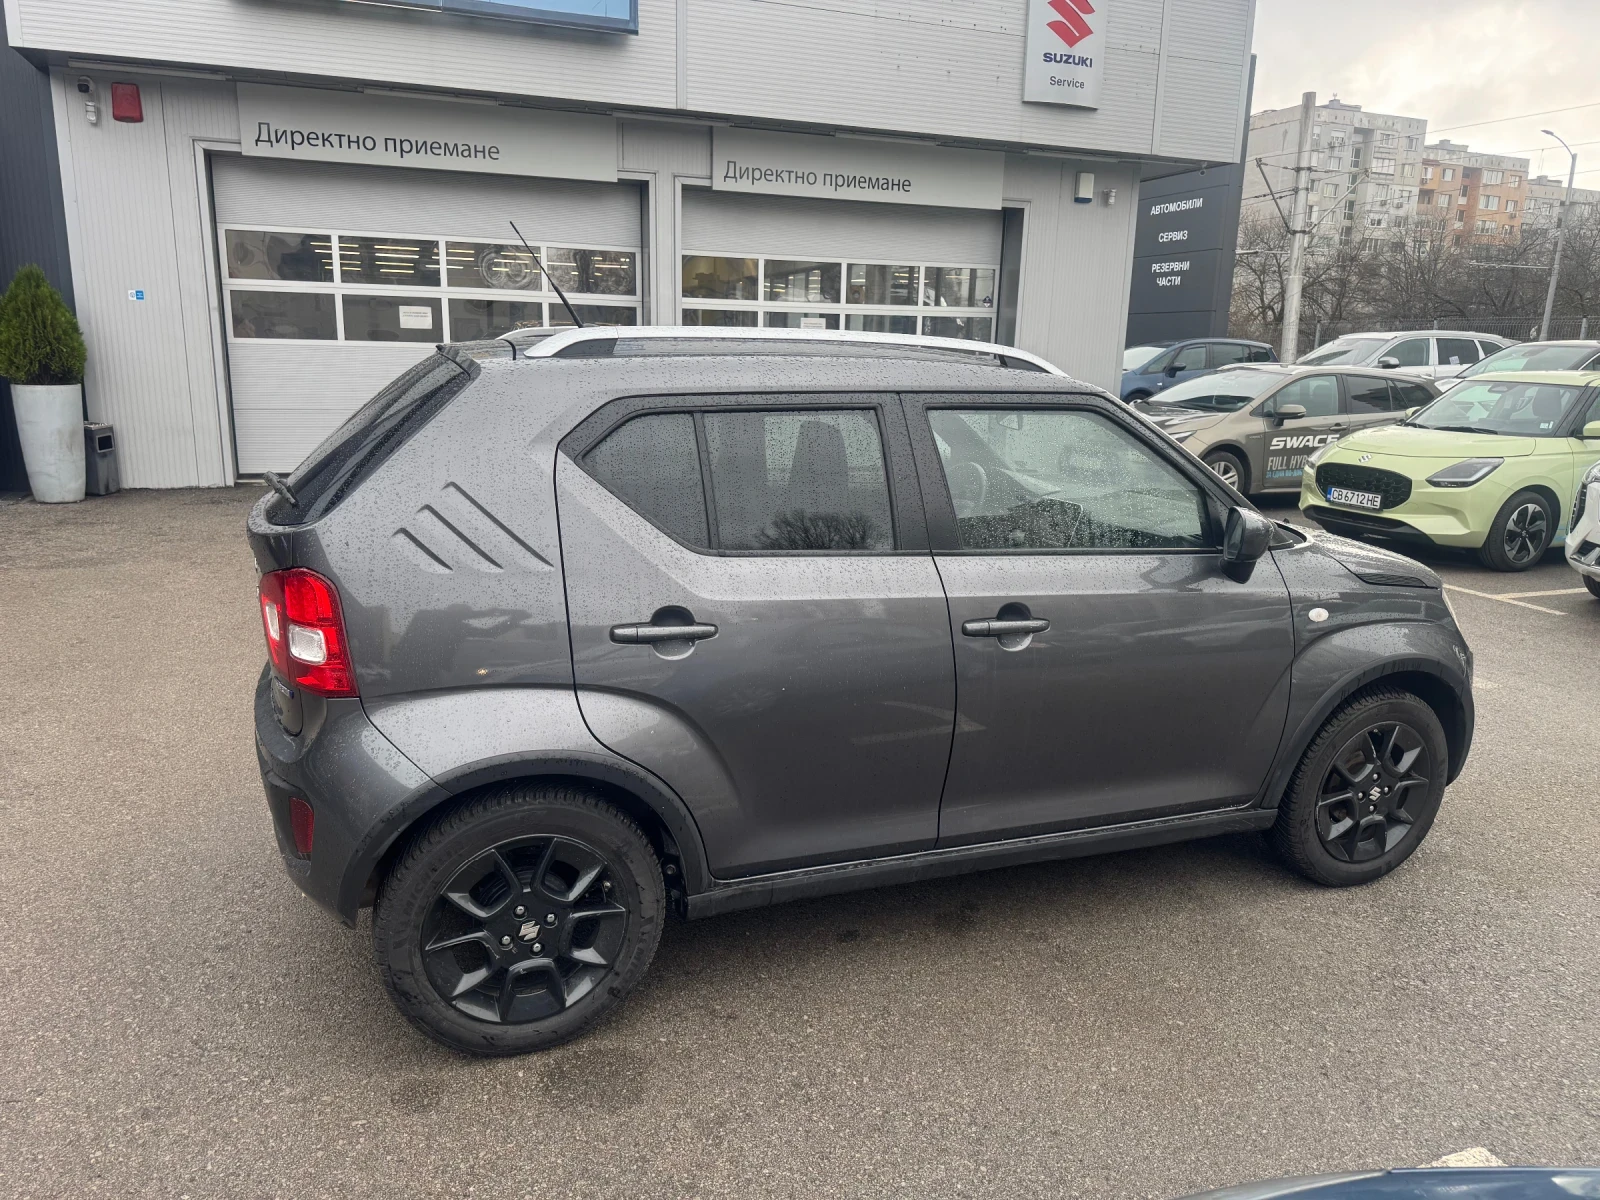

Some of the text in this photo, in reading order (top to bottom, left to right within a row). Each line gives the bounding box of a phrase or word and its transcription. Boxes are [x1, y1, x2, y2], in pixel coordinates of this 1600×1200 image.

[1043, 52, 1093, 68] SUZUKI
[1049, 75, 1085, 89] Service
[255, 121, 500, 160] Директно приемане
[723, 160, 911, 192] Директно приемане
[1150, 198, 1203, 216] АВТОМОБИЛИ
[1158, 230, 1188, 242] СЕРВИЗ
[1151, 261, 1190, 273] РЕЗЕРВНИ
[1156, 276, 1181, 287] ЧАСТИ
[1267, 456, 1287, 471] FULL
[1332, 489, 1379, 507] CB 6712 HE
